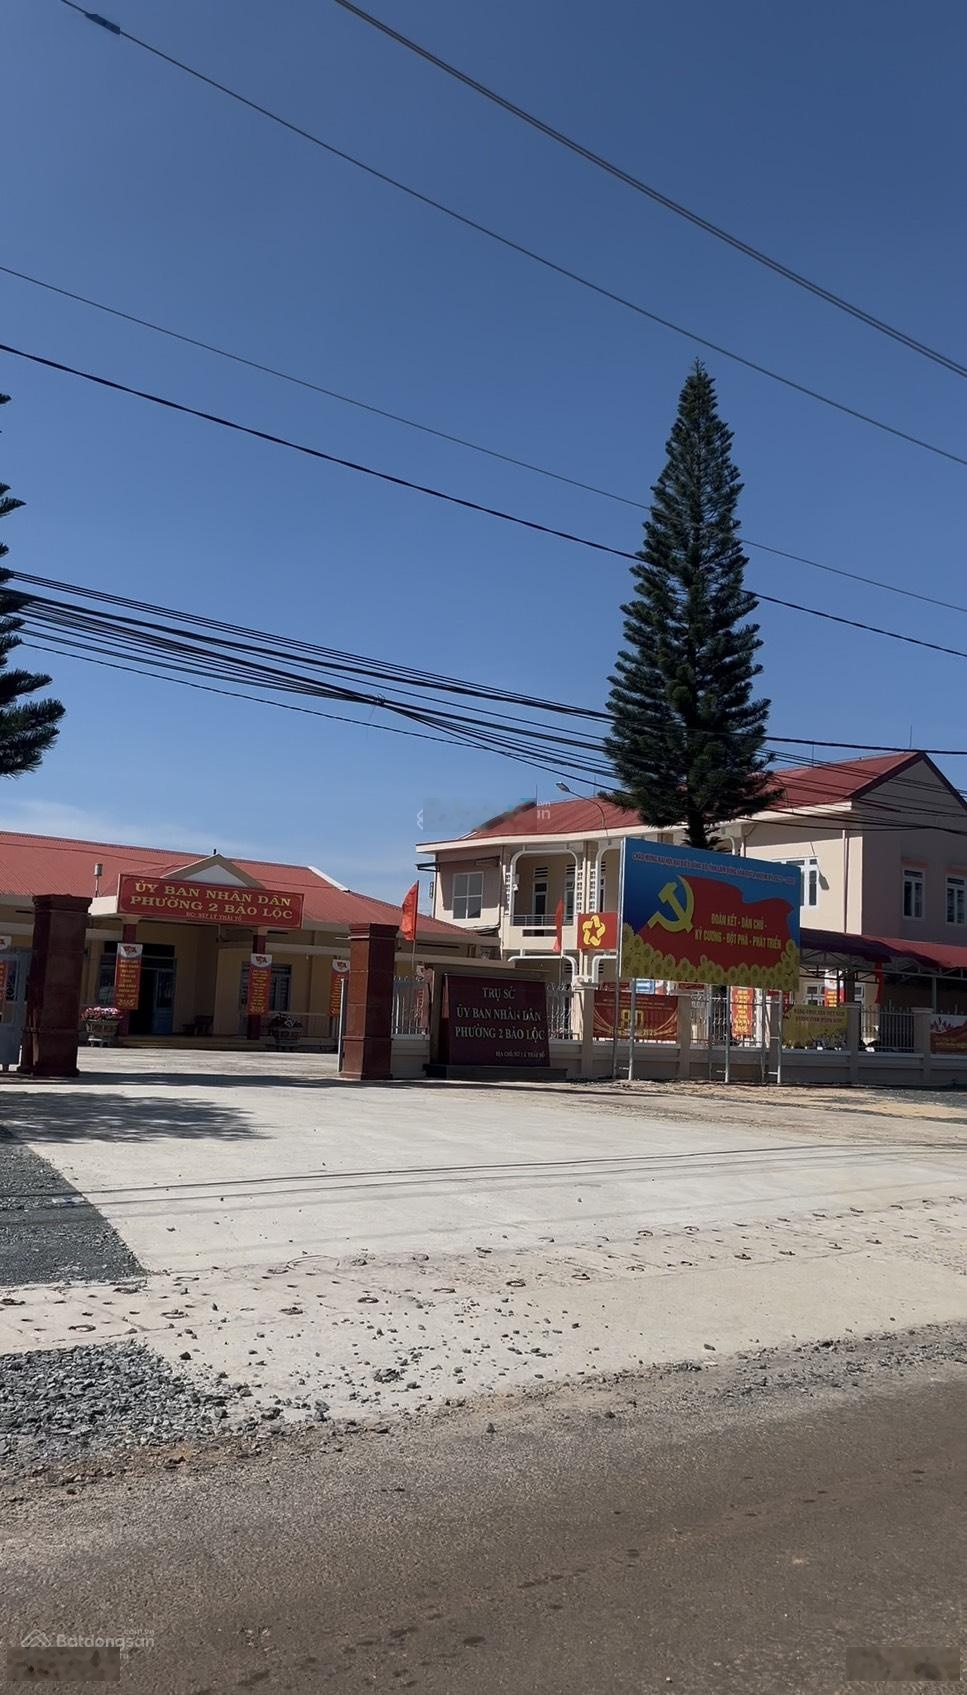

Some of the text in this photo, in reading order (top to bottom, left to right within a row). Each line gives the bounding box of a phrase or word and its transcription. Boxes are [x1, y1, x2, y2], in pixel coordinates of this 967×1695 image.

[135, 880, 291, 907] ỦY BAN NHÂN DÂN
[130, 894, 293, 919] PHƯỜNG 2 BẢO LỘC
[482, 987, 501, 1002] TRỤ
[456, 1003, 541, 1021] ỦY BAN NHÂN DÂN
[455, 1023, 496, 1039] PHƯỜNG
[498, 1028, 504, 1039] 2
[526, 1026, 545, 1043] LỘC
